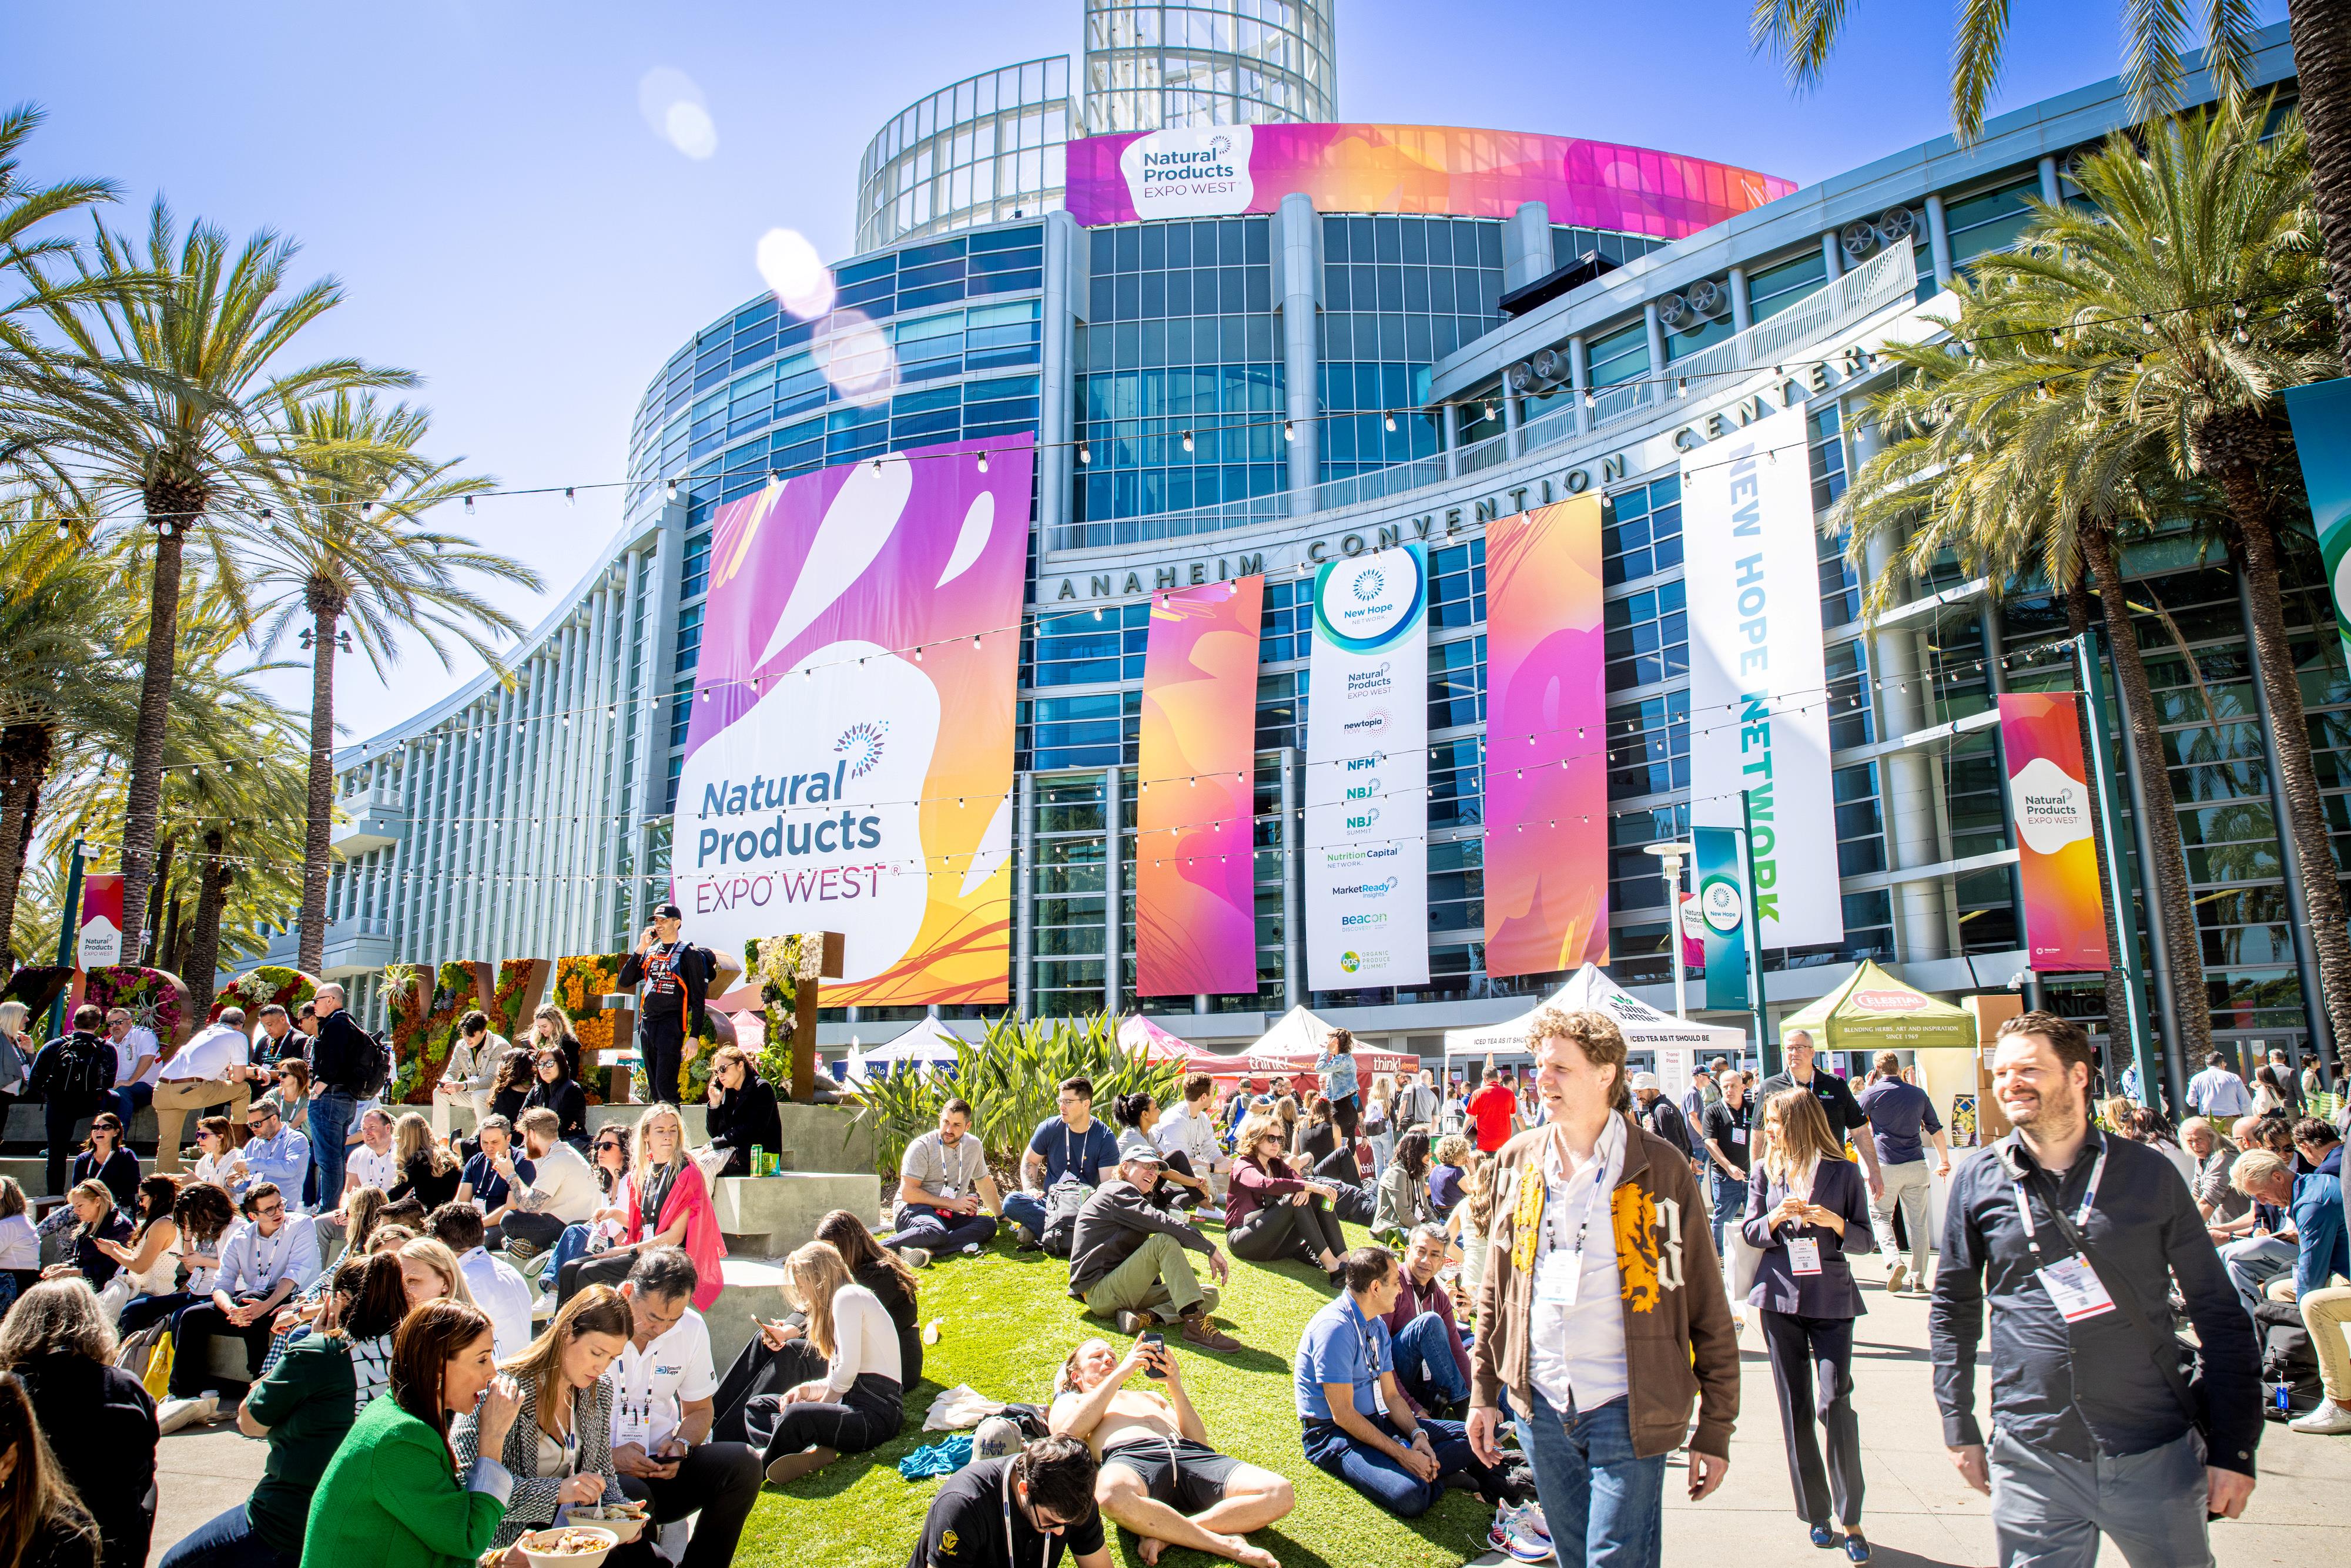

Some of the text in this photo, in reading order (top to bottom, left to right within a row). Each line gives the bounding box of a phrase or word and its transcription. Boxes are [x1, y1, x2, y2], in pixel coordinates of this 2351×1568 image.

[1144, 148, 1216, 166] Natural
[1144, 164, 1234, 182] Products
[1144, 185, 1187, 198] EXPO
[1058, 344, 1864, 600] ANAHEIM CONVENTION CENTER
[1344, 603, 1393, 619] New Hope
[1348, 669, 1384, 682] Natural
[1348, 677, 1391, 691] Products
[1729, 442, 1780, 924] NEW HOPE NETWORK
[1348, 686, 1392, 699] EXPO WEST
[1344, 718, 1382, 730] newtopia
[1347, 758, 1375, 771] NFM
[702, 759, 847, 820] Natural
[1347, 786, 1372, 800] NBJ
[2025, 795, 2066, 805] Natural
[2026, 805, 2077, 815] Products
[1347, 815, 1372, 829] NBJ
[698, 810, 882, 868] Products
[697, 875, 772, 914] EXPO
[1332, 882, 1390, 896] MarketReady
[1684, 909, 1703, 917] Natural
[1342, 956, 1359, 967] ops
[1858, 995, 1923, 1007] CELESTIAL
[1609, 1002, 1652, 1016] Saint
[1618, 1011, 1662, 1023] James
[939, 1065, 954, 1073] Gut
[1248, 1056, 1288, 1070] think!
[1373, 1057, 1418, 1072] think! strong
[982, 1447, 1004, 1456] TOWN
